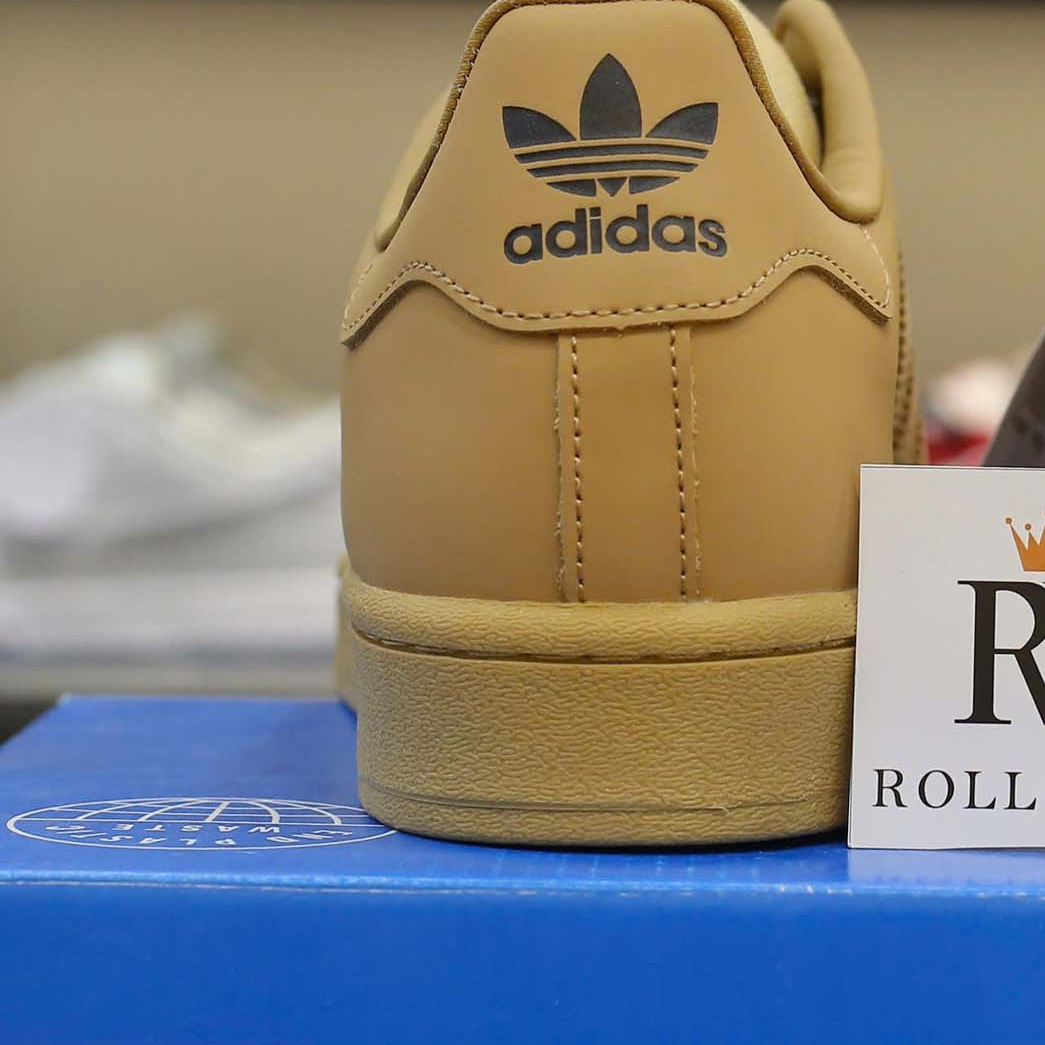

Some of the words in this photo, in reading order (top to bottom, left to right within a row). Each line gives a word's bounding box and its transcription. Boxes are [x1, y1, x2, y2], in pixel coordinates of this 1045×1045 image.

[503, 204, 728, 264] adidas
[872, 769, 1037, 810] ROLL
[45, 825, 237, 846] PLASTIC
[112, 824, 281, 834] WASTE
[266, 830, 353, 843] END
